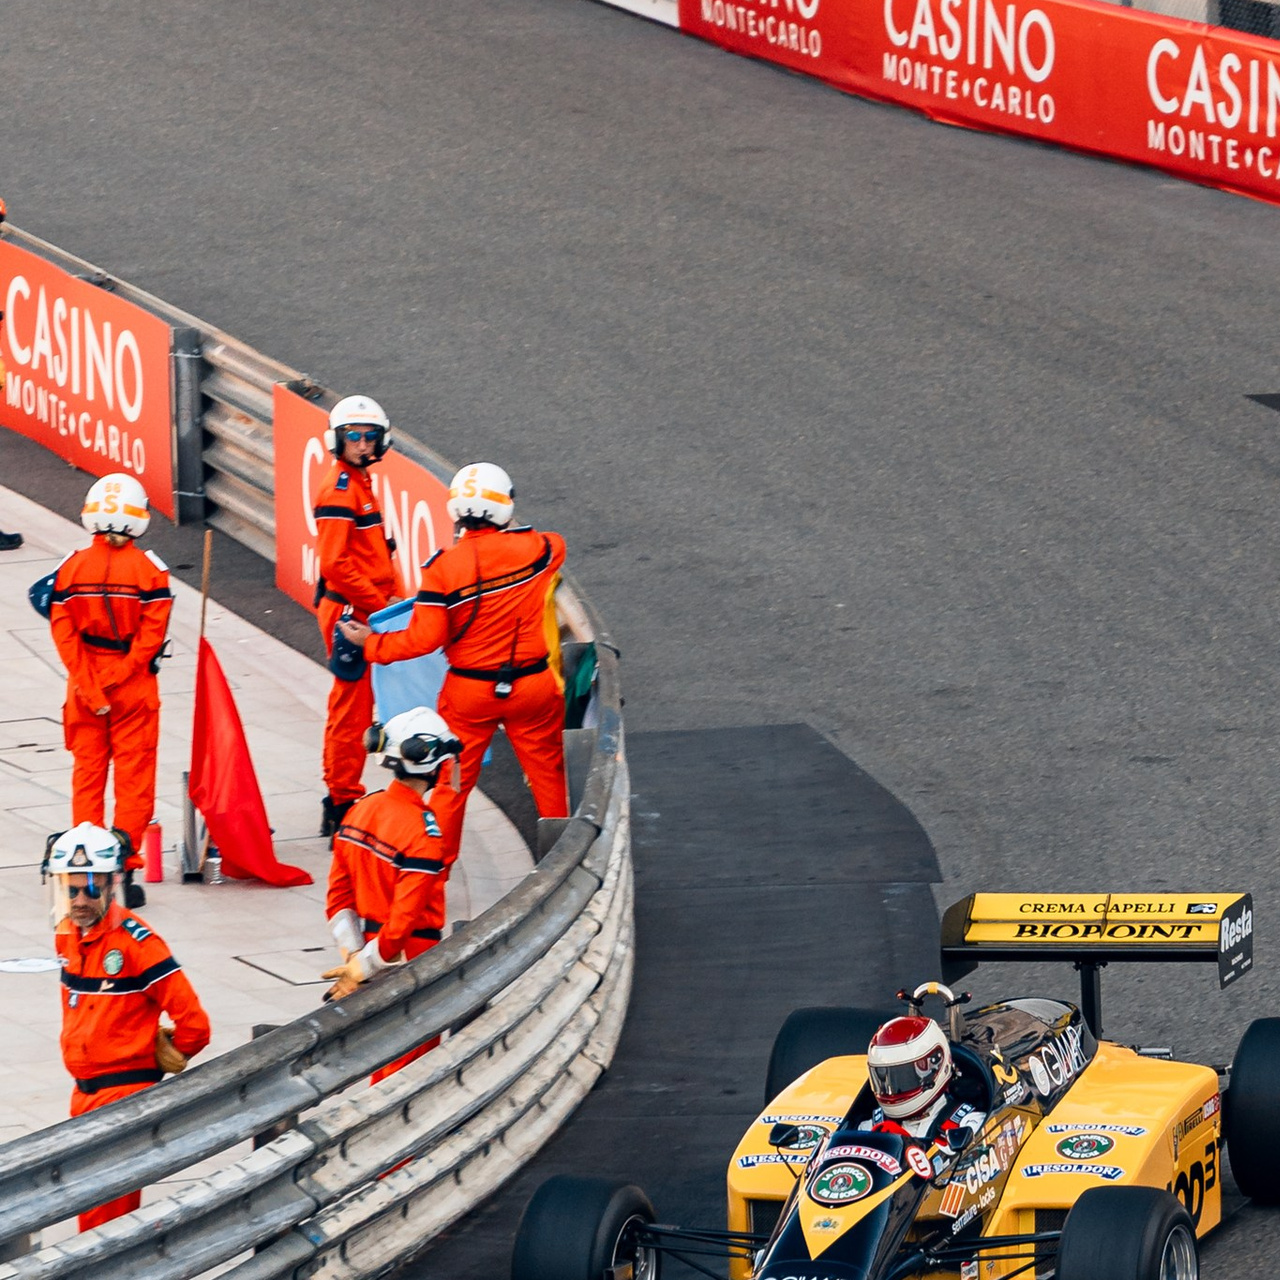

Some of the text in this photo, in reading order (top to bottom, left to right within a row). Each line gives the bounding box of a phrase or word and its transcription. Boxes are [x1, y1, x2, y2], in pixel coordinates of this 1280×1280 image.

[6, 275, 143, 423] CASINO
[302, 437, 435, 591] CNO
[1013, 923, 1202, 939] BIOPOINT
[1019, 903, 1085, 913] CREMA
[1093, 903, 1175, 913] CAPELLI
[1221, 905, 1252, 953] Resta
[966, 1146, 1000, 1195] CISA
